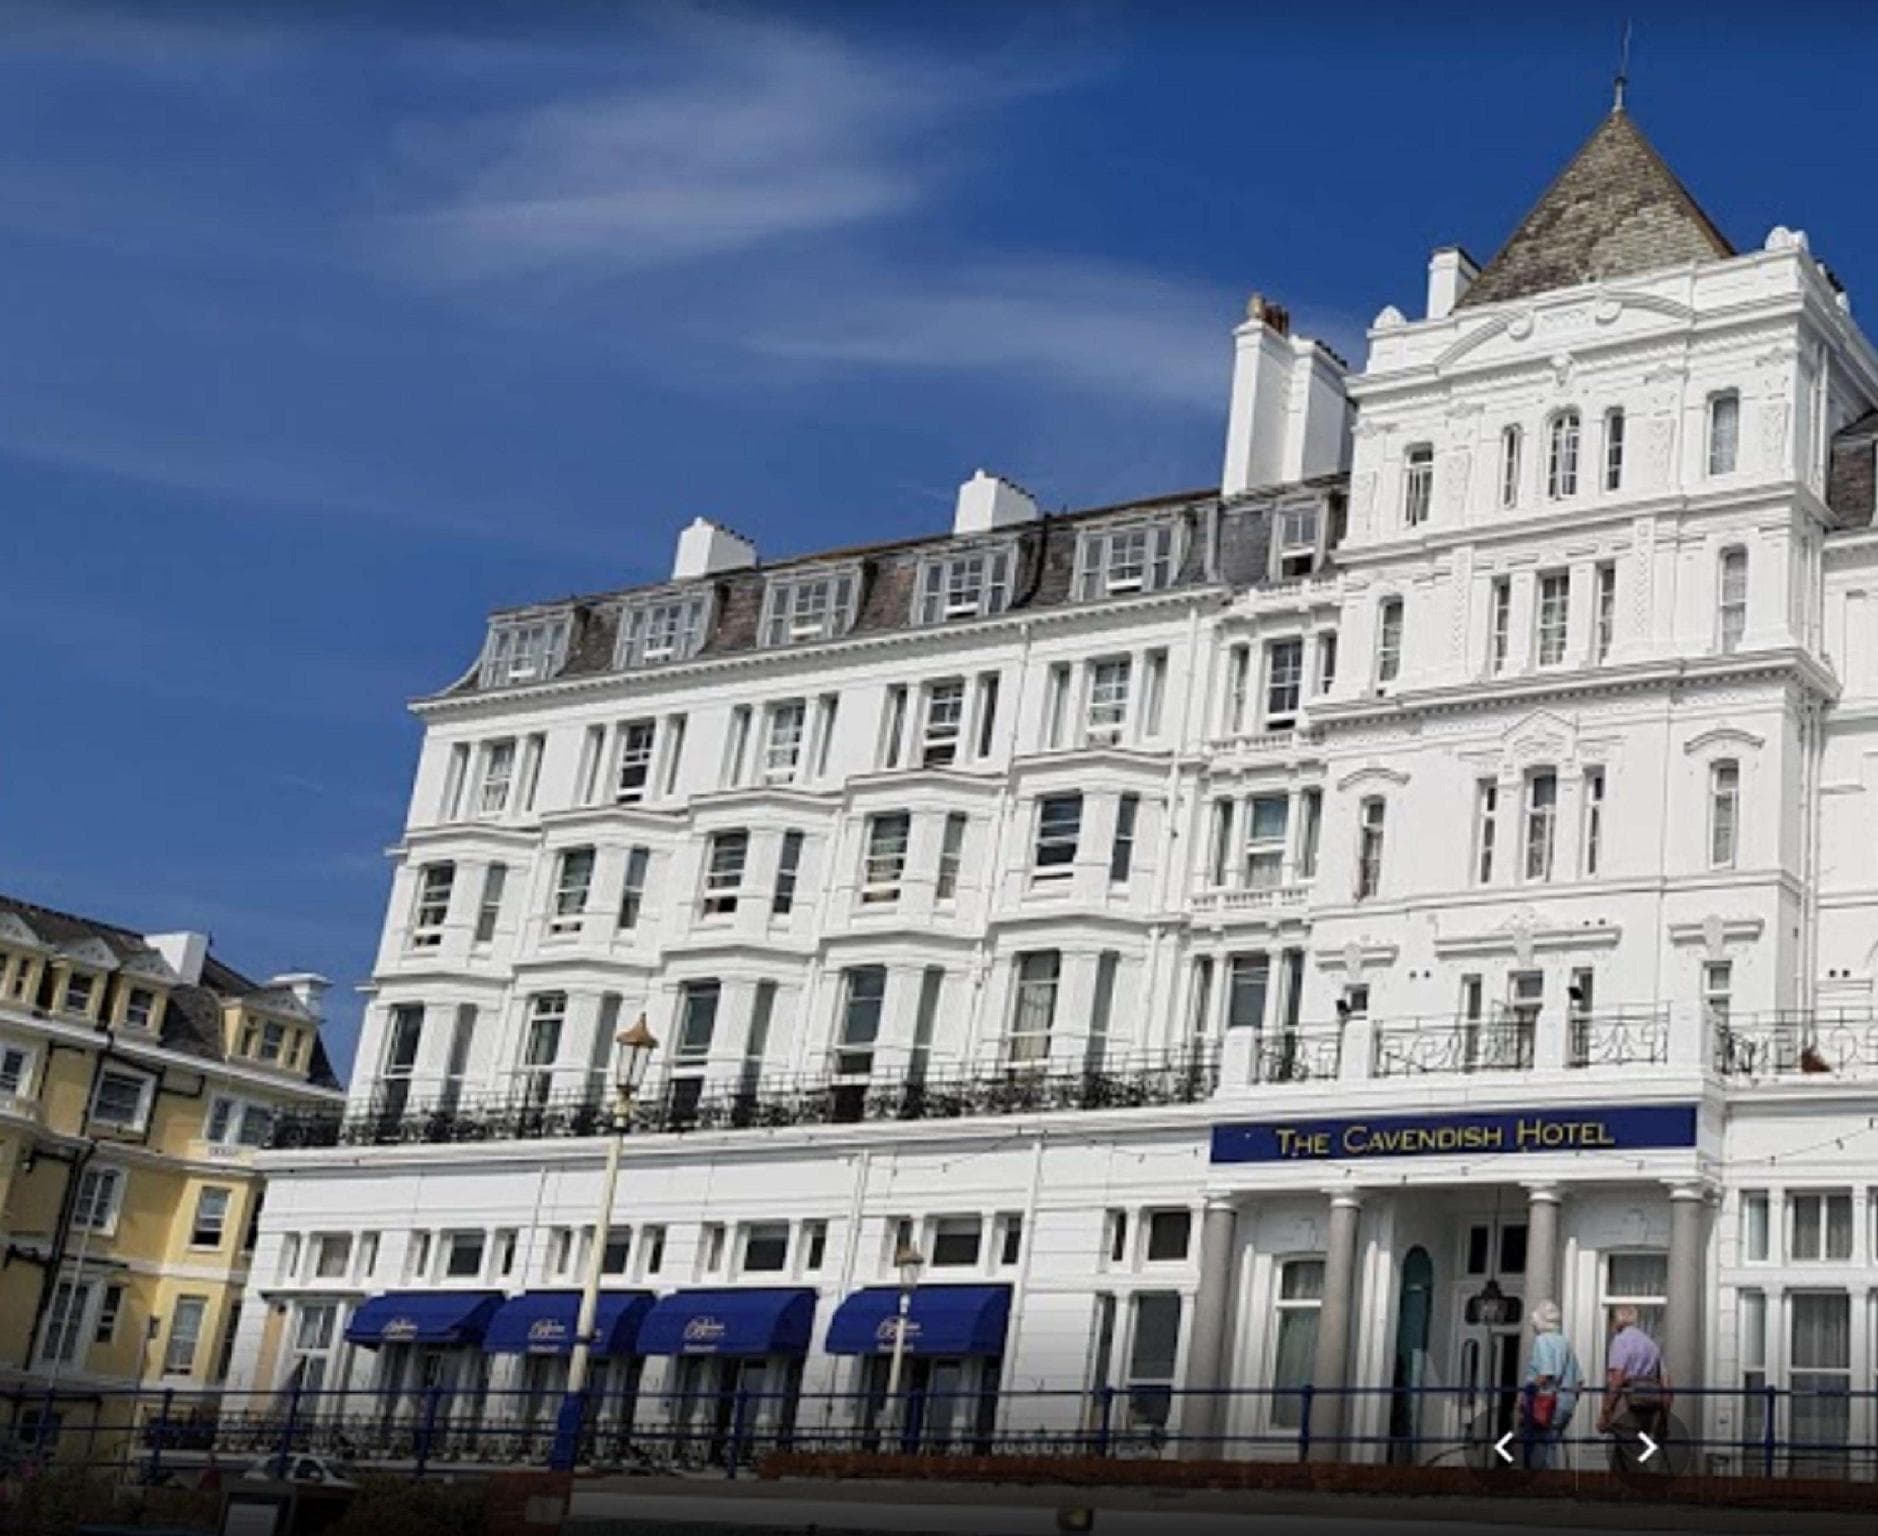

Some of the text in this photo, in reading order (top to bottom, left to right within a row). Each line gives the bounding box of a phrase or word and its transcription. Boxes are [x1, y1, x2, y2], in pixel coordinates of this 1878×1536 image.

[1276, 1119, 1615, 1155] THE CAVENDISH HOTEL
